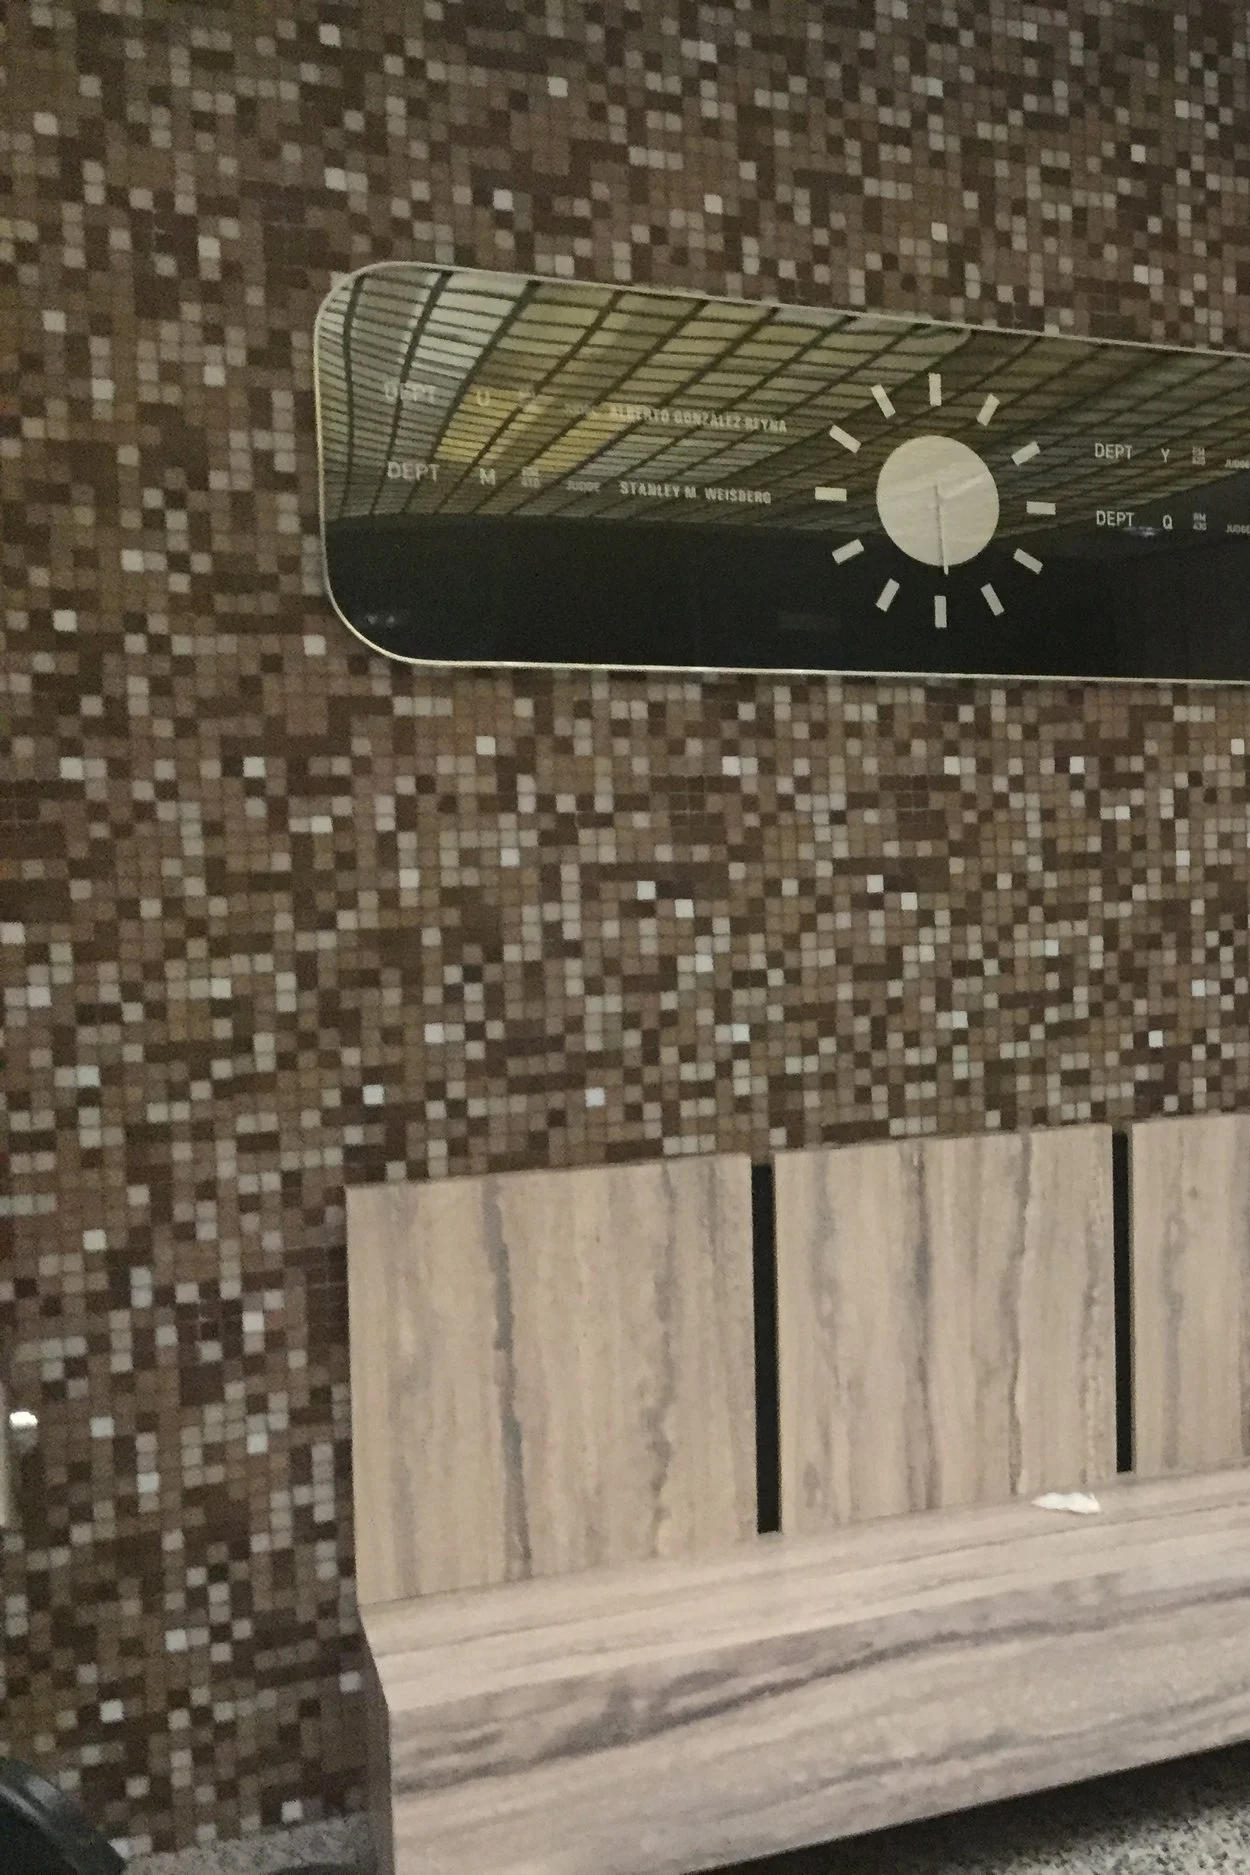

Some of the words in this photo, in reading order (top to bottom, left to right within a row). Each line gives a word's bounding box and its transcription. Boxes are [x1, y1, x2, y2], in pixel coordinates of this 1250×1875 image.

[1095, 443, 1133, 460] DEPT
[1161, 448, 1170, 463] Y
[387, 461, 440, 482] DEPT
[479, 467, 496, 486] M
[618, 481, 681, 498] STANLEY
[704, 487, 772, 504] WEISBERG
[1096, 511, 1135, 528] DEPT
[1162, 514, 1174, 530] Q
